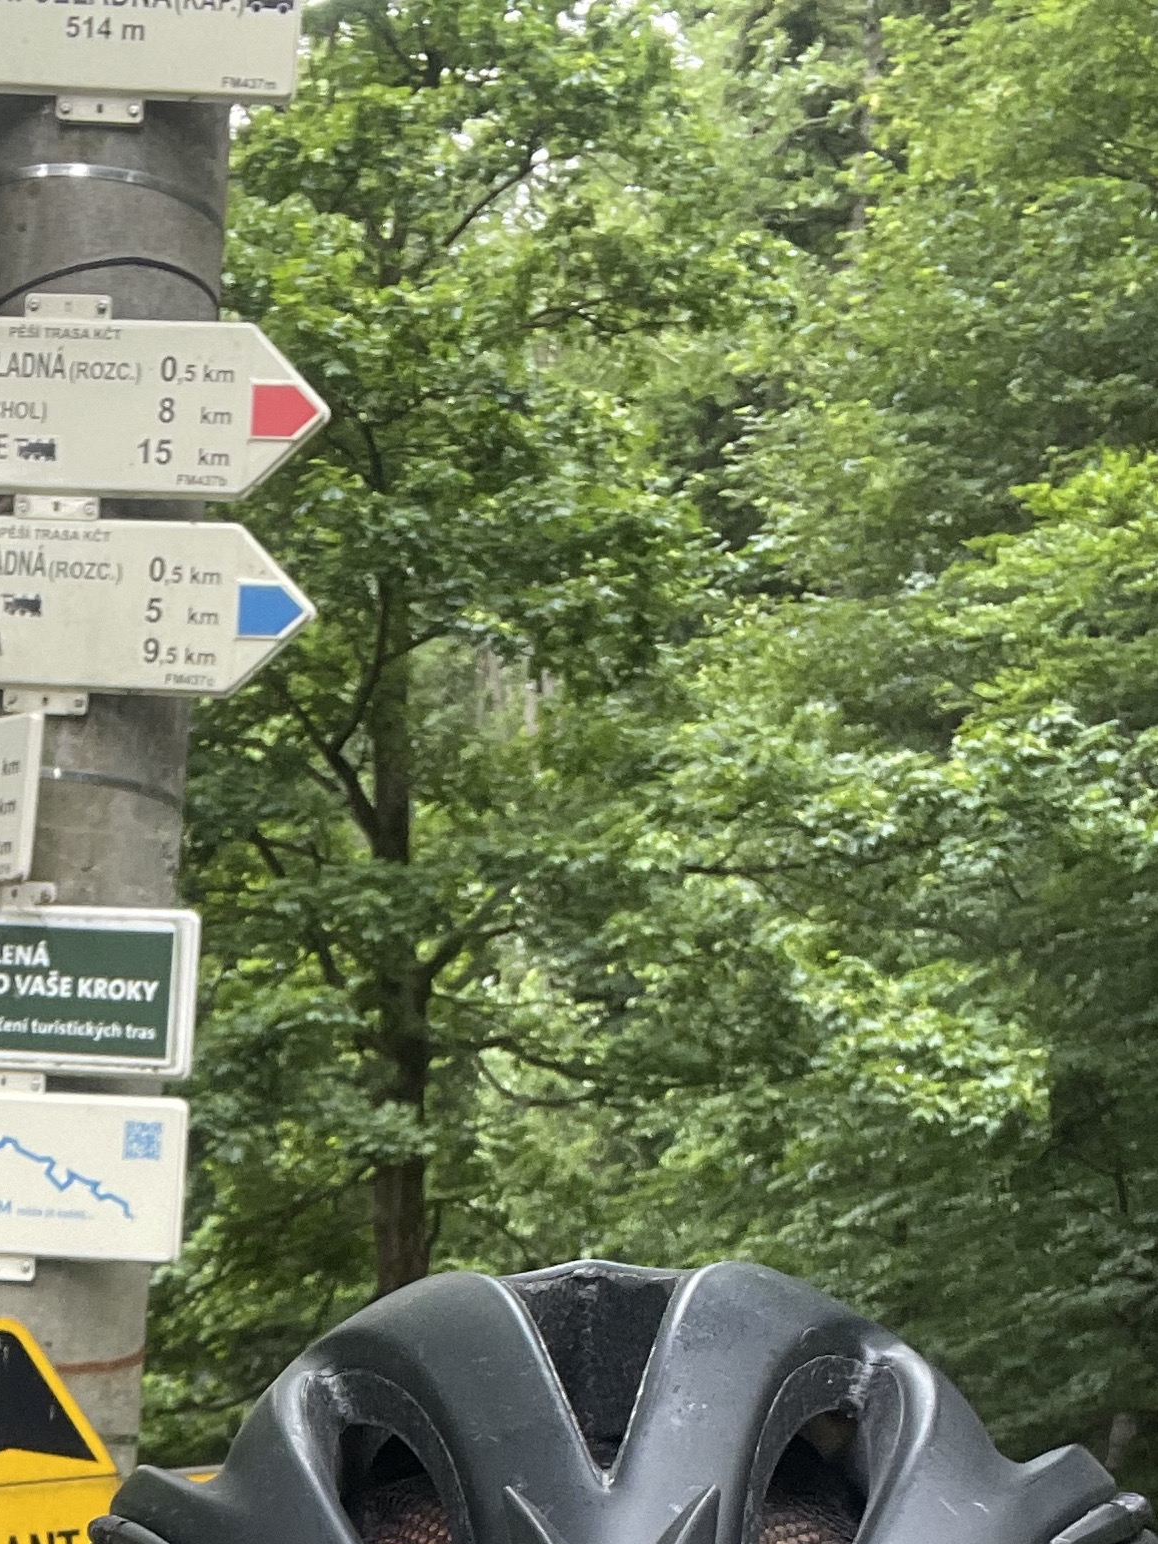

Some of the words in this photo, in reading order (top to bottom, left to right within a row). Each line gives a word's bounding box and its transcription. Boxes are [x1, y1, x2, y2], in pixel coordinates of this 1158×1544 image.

[65, 16, 112, 40] 514
[121, 22, 146, 41] m
[44, 326, 89, 340] TRASA
[69, 361, 141, 386] (ROZC.)
[203, 363, 236, 384] km
[158, 397, 175, 424] 8
[200, 405, 233, 426] km
[138, 438, 173, 467] 15
[197, 447, 231, 468] km
[37, 529, 80, 543] TRASA
[47, 561, 124, 585] (ROZC.)
[189, 567, 223, 587] km
[144, 597, 162, 624] 5
[187, 607, 220, 627] km
[183, 648, 217, 667] km
[1, 758, 22, 777] km
[15, 970, 71, 999] VAŠE
[77, 978, 159, 1003] KROKY
[31, 1018, 122, 1042] turistických
[125, 1022, 157, 1041] tras
